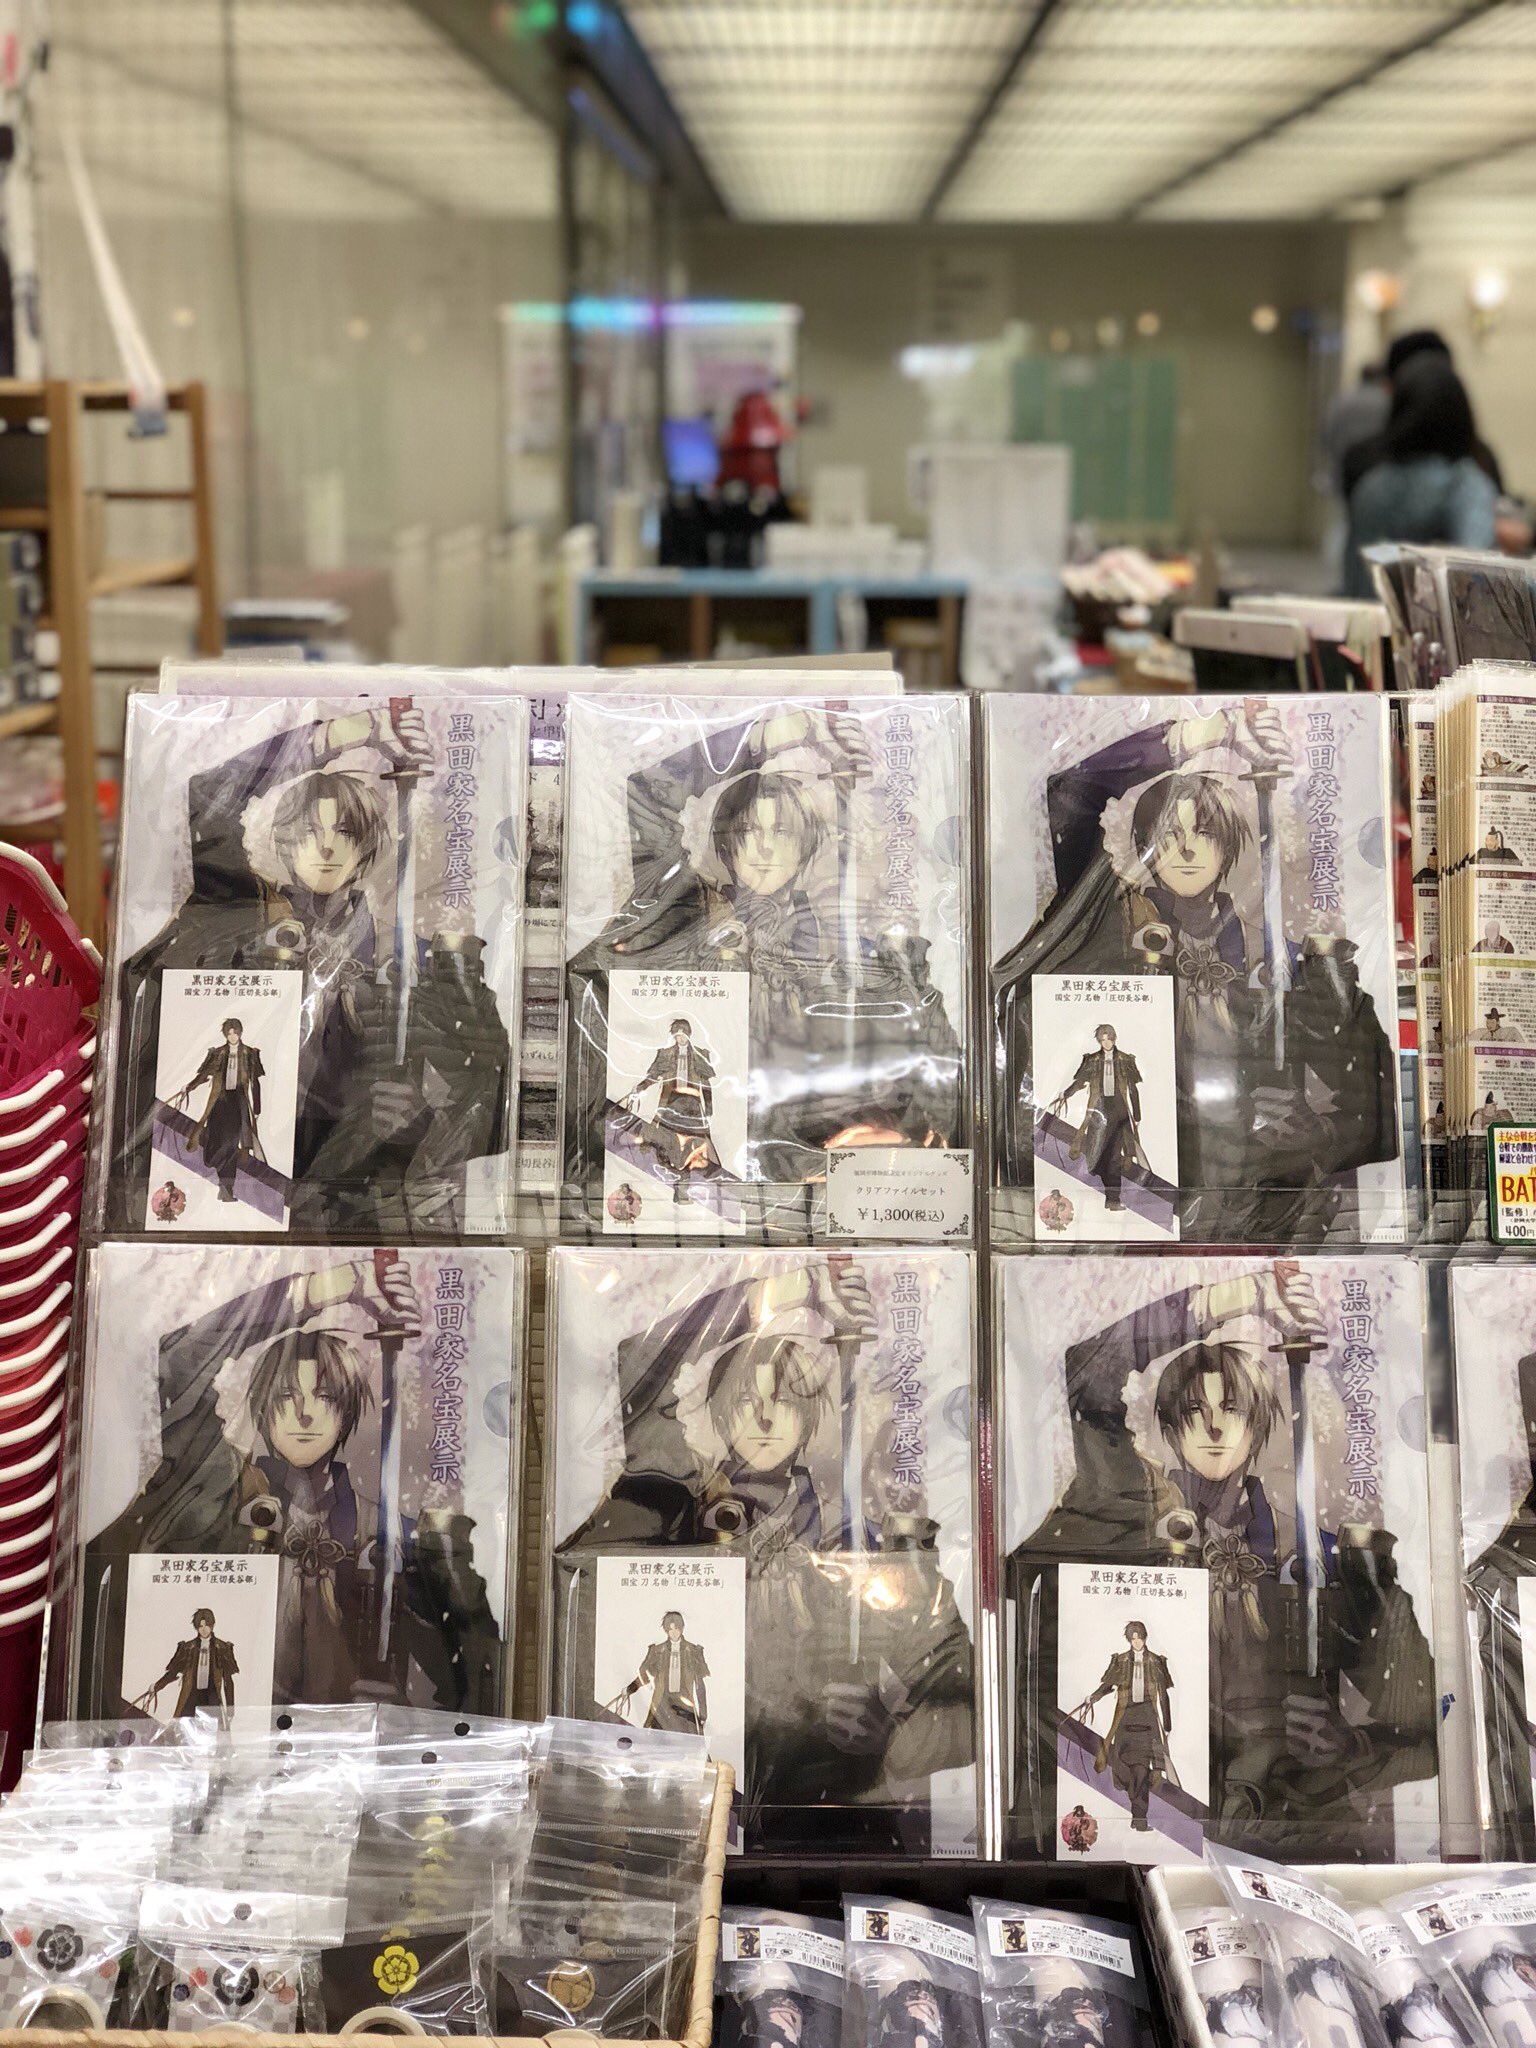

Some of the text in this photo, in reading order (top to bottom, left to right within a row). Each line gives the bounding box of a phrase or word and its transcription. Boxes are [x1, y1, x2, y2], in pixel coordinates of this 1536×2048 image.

[444, 714, 475, 908] 黒田家名宝展示
[884, 714, 914, 908] 黒田家名宝展示
[1305, 713, 1340, 911] 黒田家名宝展示
[191, 975, 273, 986] 黒田家名宝展示
[638, 975, 721, 987] 黒田家名宝展示
[1061, 980, 1144, 992] 黒田家名宝展示
[1498, 1131, 1536, 1141] 主な合戦を
[856, 1186, 946, 1196] クリアファイルセット
[430, 1268, 465, 1484] 黒田家名宝展示
[891, 1272, 922, 1488] 黒田家名宝展示
[1340, 1279, 1377, 1499] 黒田家名宝展示
[160, 1559, 248, 1572] 黒田家名宝展示
[628, 1562, 715, 1575] 黒田家名宝展示
[1090, 1570, 1177, 1585] 黒田家名宝展示
